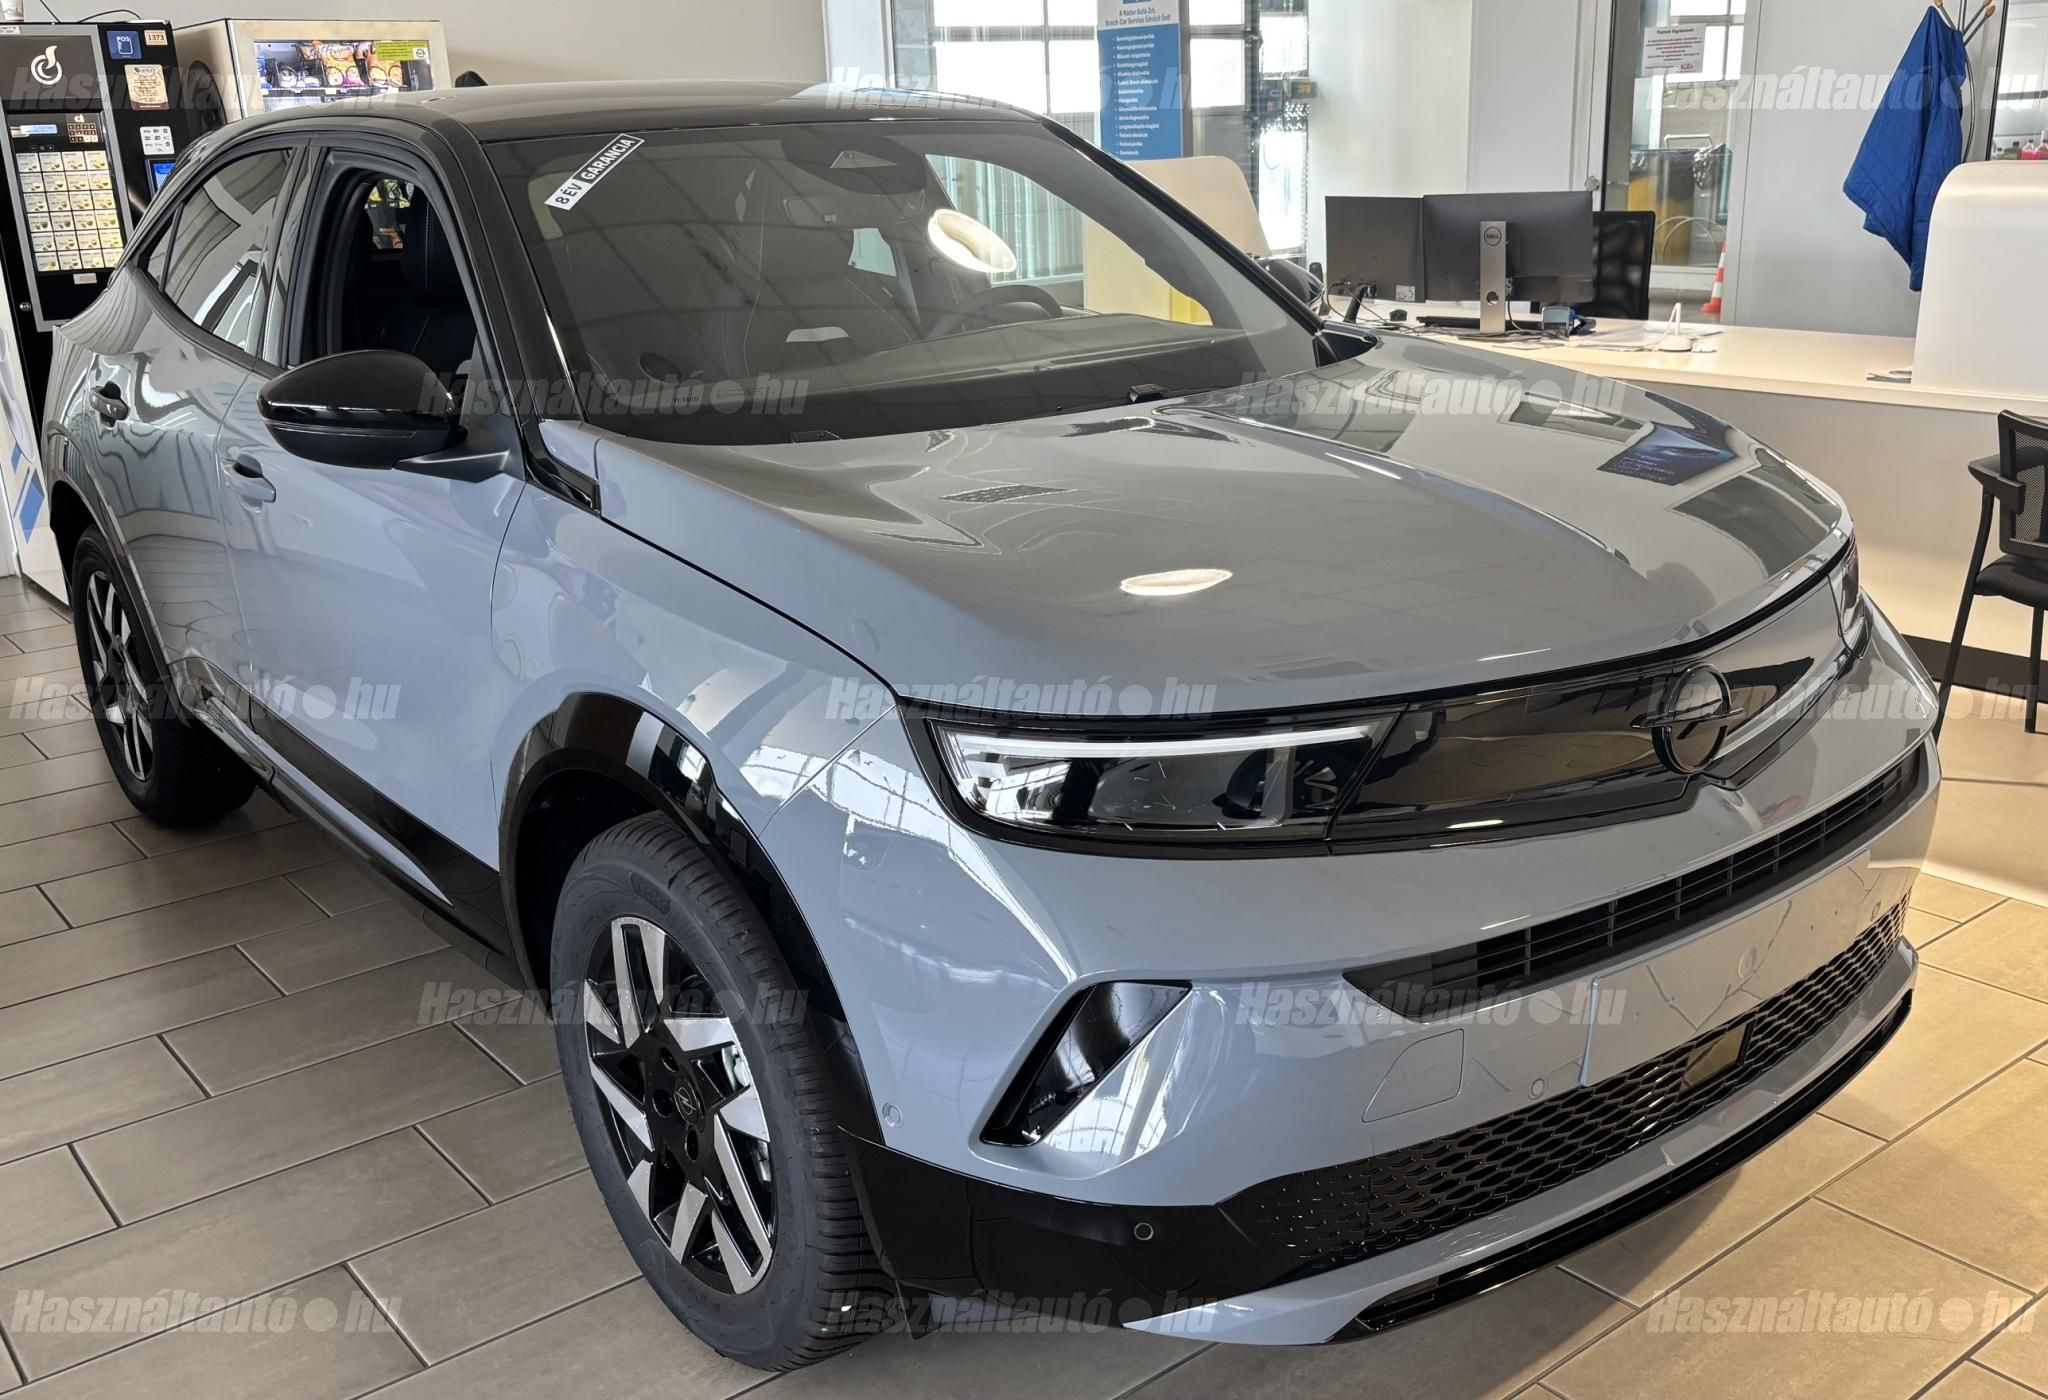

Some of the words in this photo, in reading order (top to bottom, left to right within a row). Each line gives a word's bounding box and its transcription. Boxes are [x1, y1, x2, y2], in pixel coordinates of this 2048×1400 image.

[580, 139, 636, 180] GARANCIA
[560, 183, 582, 197] ÉV
[555, 196, 570, 204] 8
